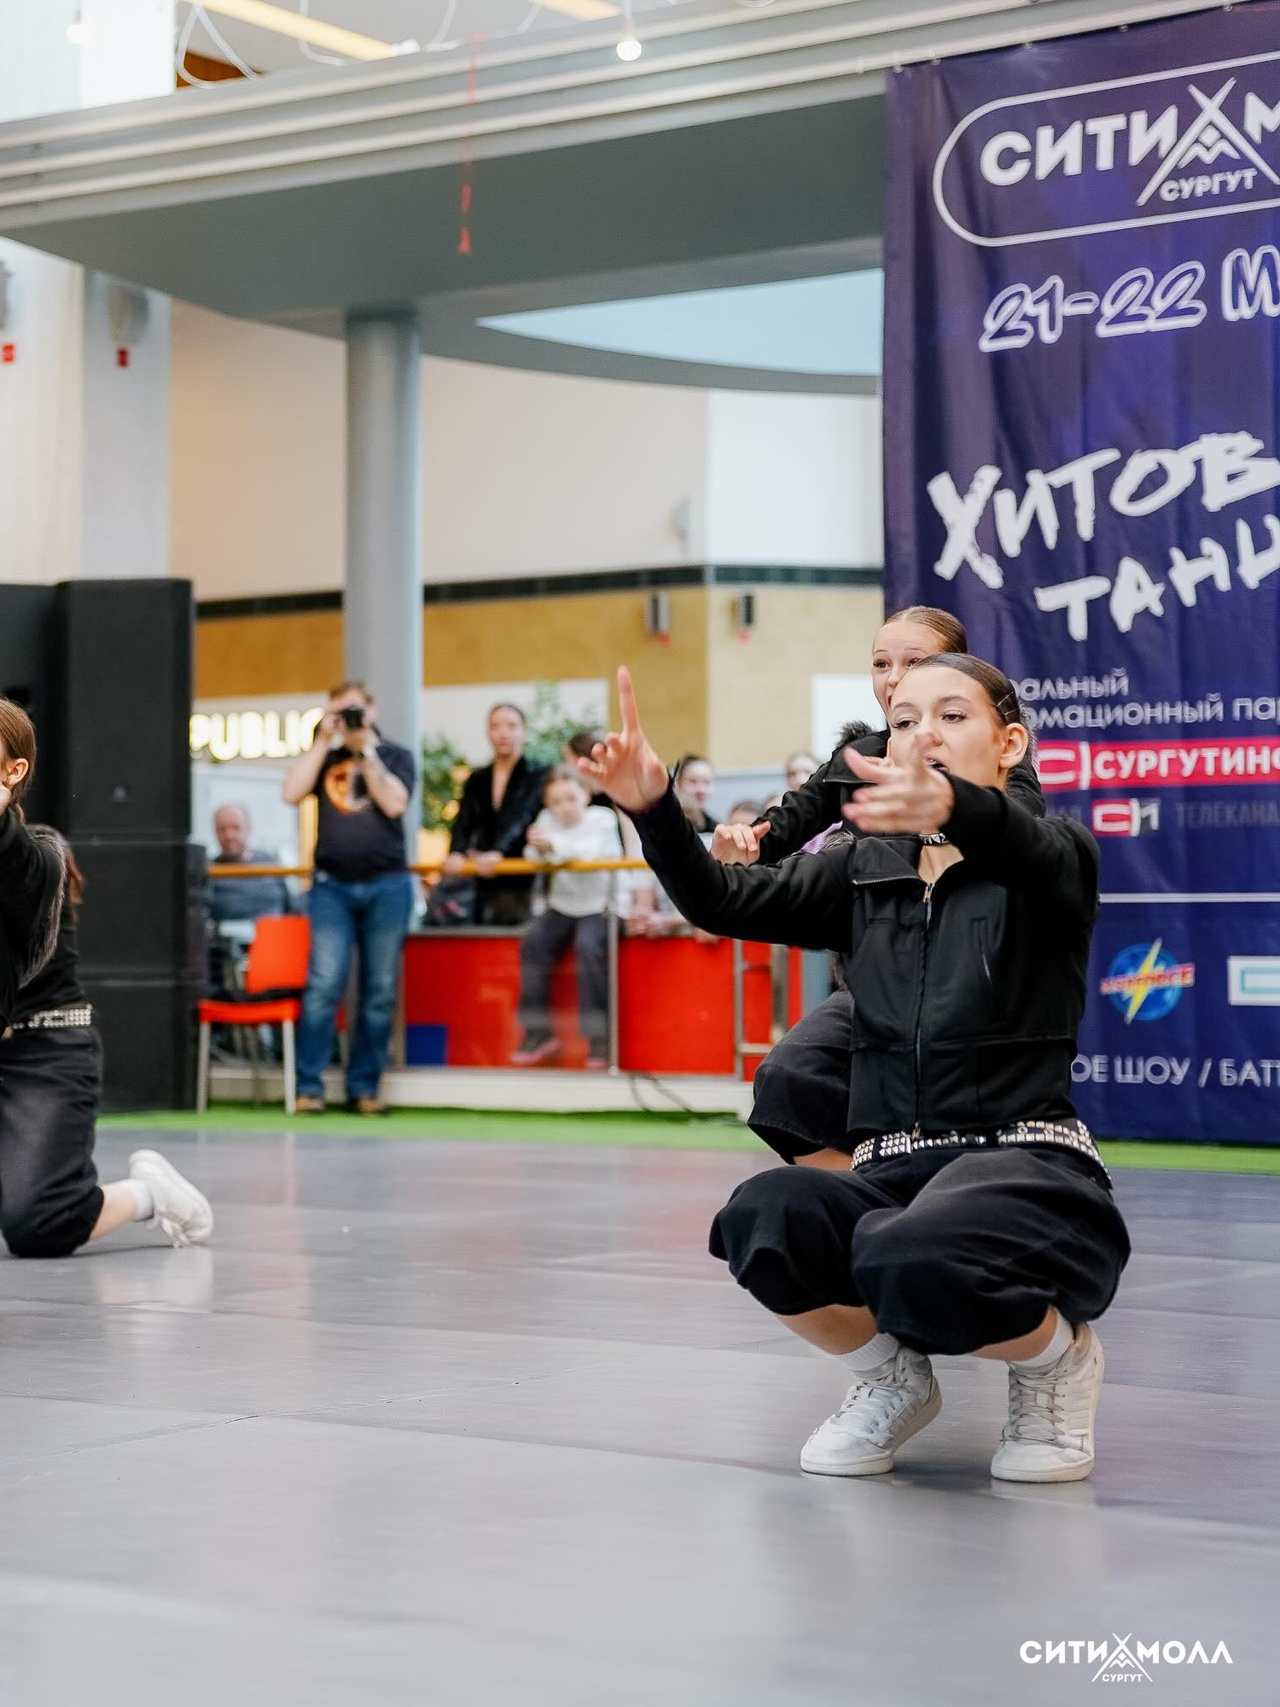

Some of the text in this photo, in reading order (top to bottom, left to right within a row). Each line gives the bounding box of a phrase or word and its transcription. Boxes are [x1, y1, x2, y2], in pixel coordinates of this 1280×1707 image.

[980, 104, 1179, 186] СИТИ
[1159, 168, 1258, 201] СУРГУТ
[978, 260, 1208, 353] 21-22
[926, 430, 1280, 589] ХИТОВ
[1232, 696, 1280, 726] па
[1114, 1055, 1191, 1085] ШОУ
